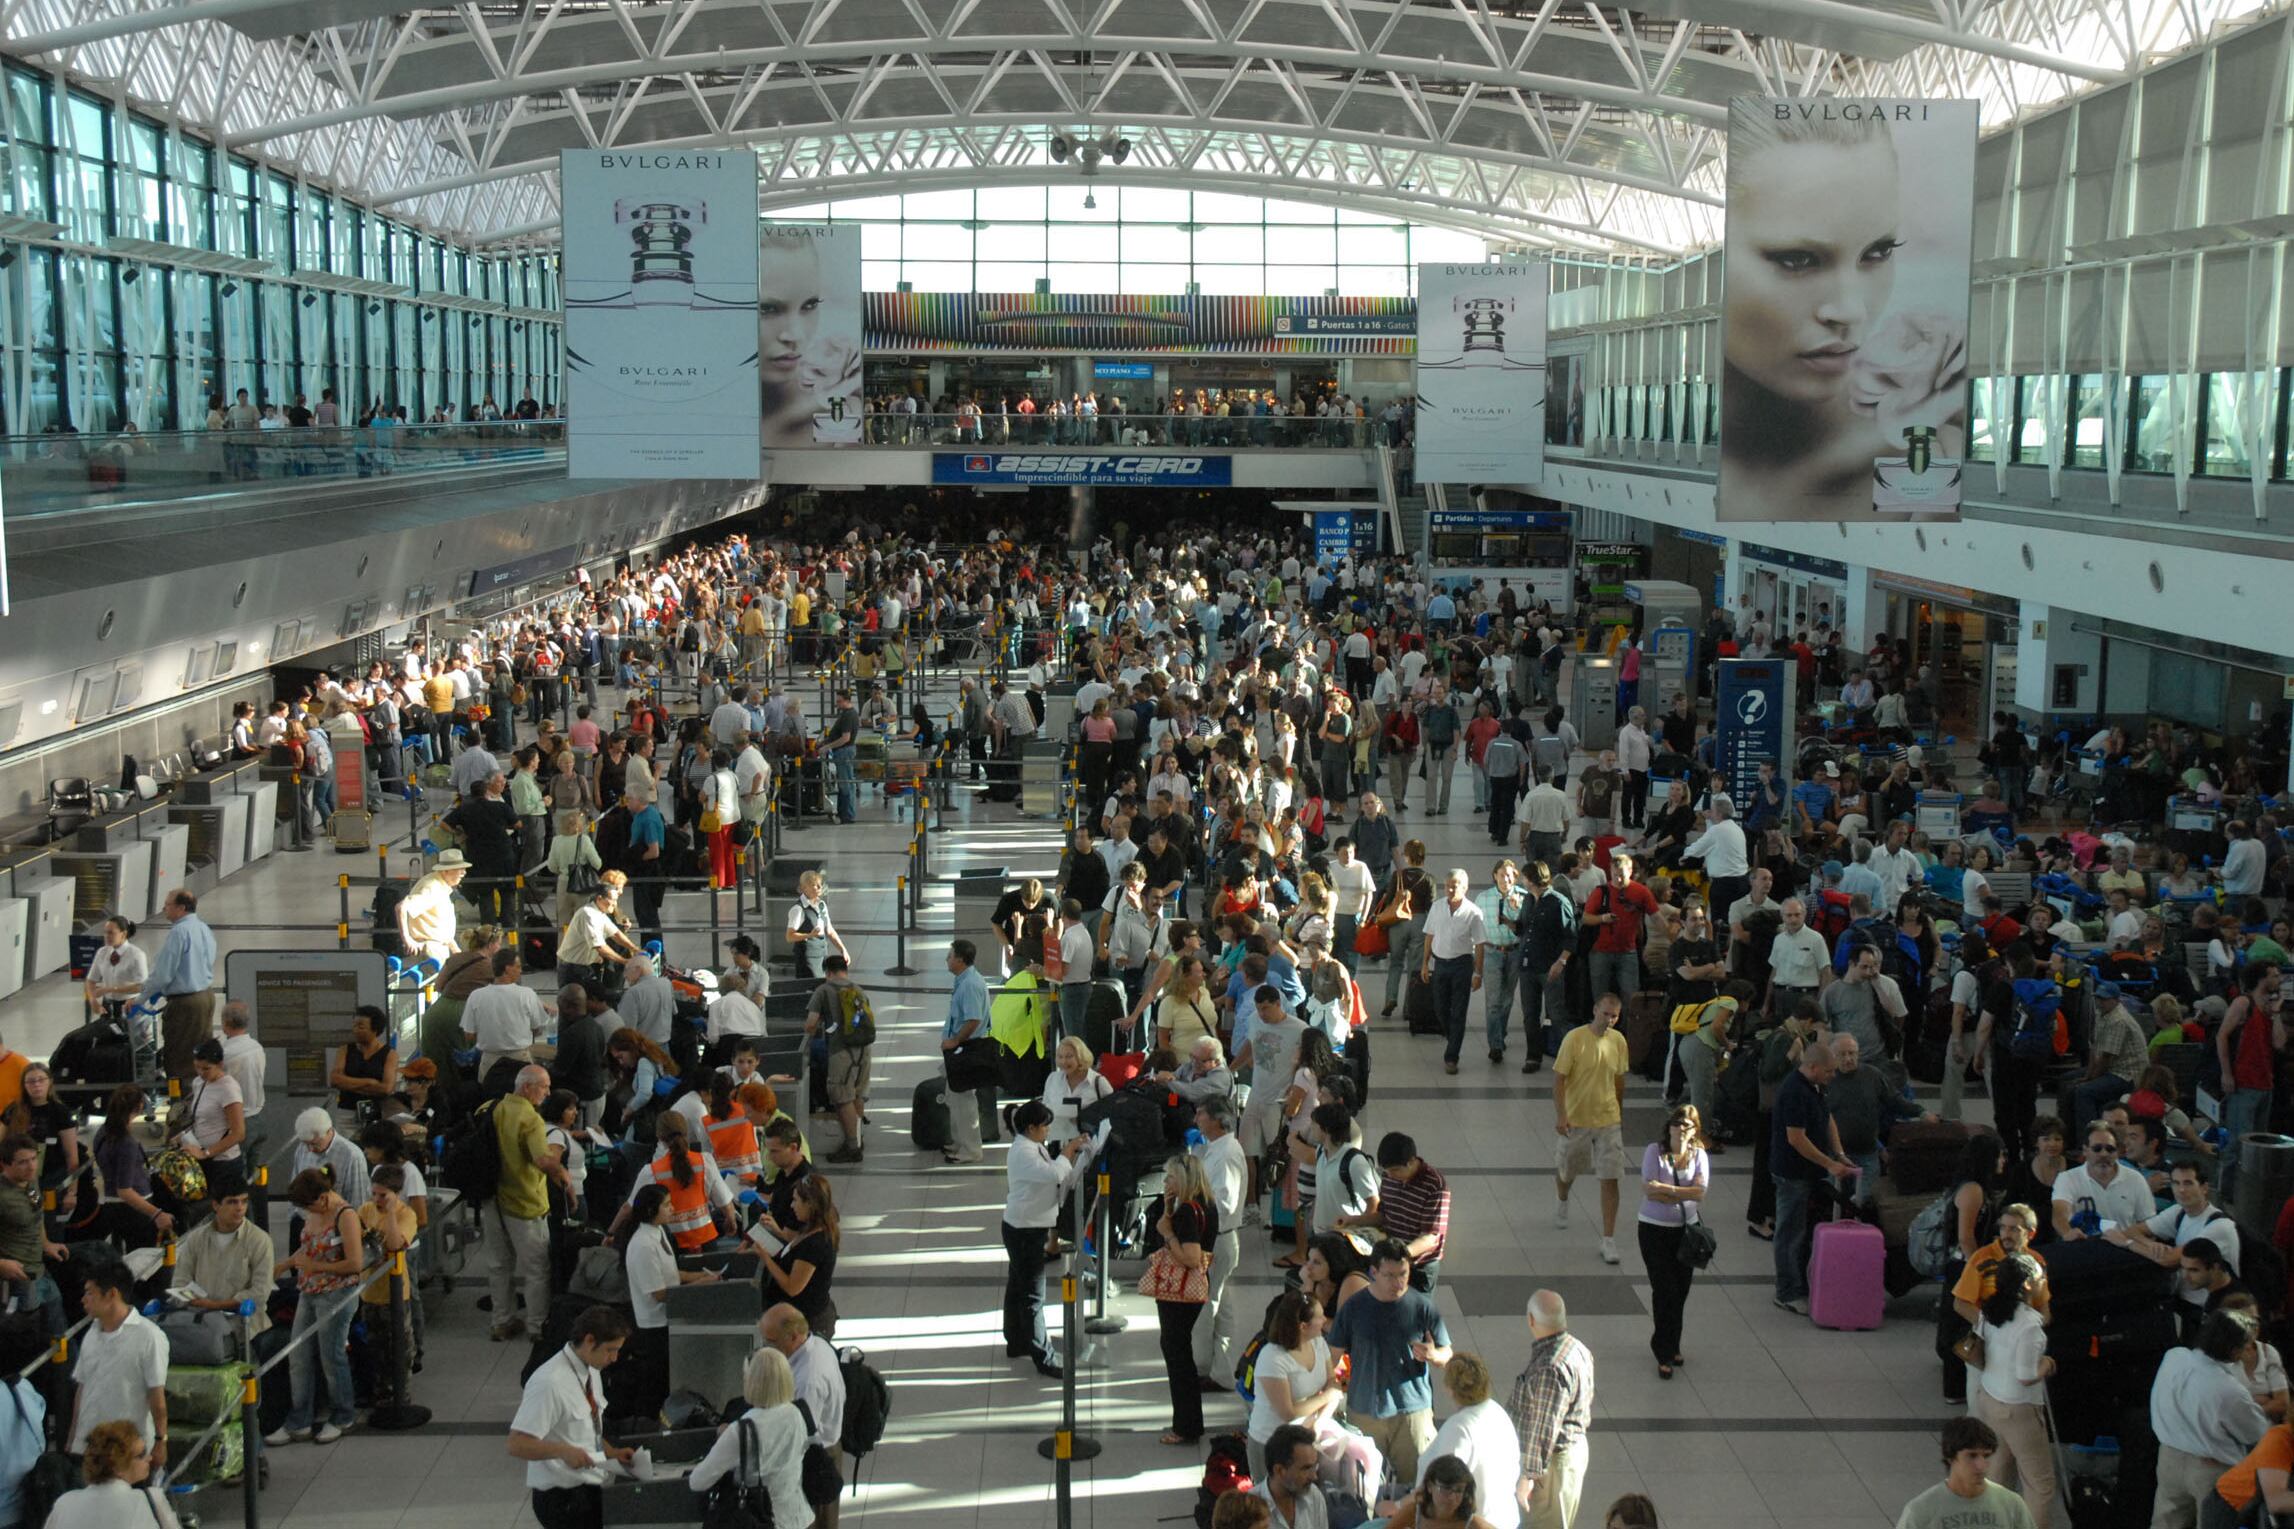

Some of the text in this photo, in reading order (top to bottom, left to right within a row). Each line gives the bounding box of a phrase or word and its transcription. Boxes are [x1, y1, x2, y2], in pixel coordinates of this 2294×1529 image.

[1775, 103, 1928, 121] BVLGARI
[601, 155, 722, 169] BVLGARI
[763, 227, 834, 237] VLGARI
[1445, 266, 1526, 276] BVLGARI
[1321, 321, 1355, 329] Puertas
[1358, 321, 1363, 329] 1
[1371, 321, 1381, 329] 16
[1387, 321, 1410, 330] Gates
[620, 367, 707, 376] BVLGARI
[1015, 473, 1153, 484] Imprescindible para su viaje
[1445, 514, 1513, 523] Partidas Departures
[1586, 545, 1632, 555] TrueStar
